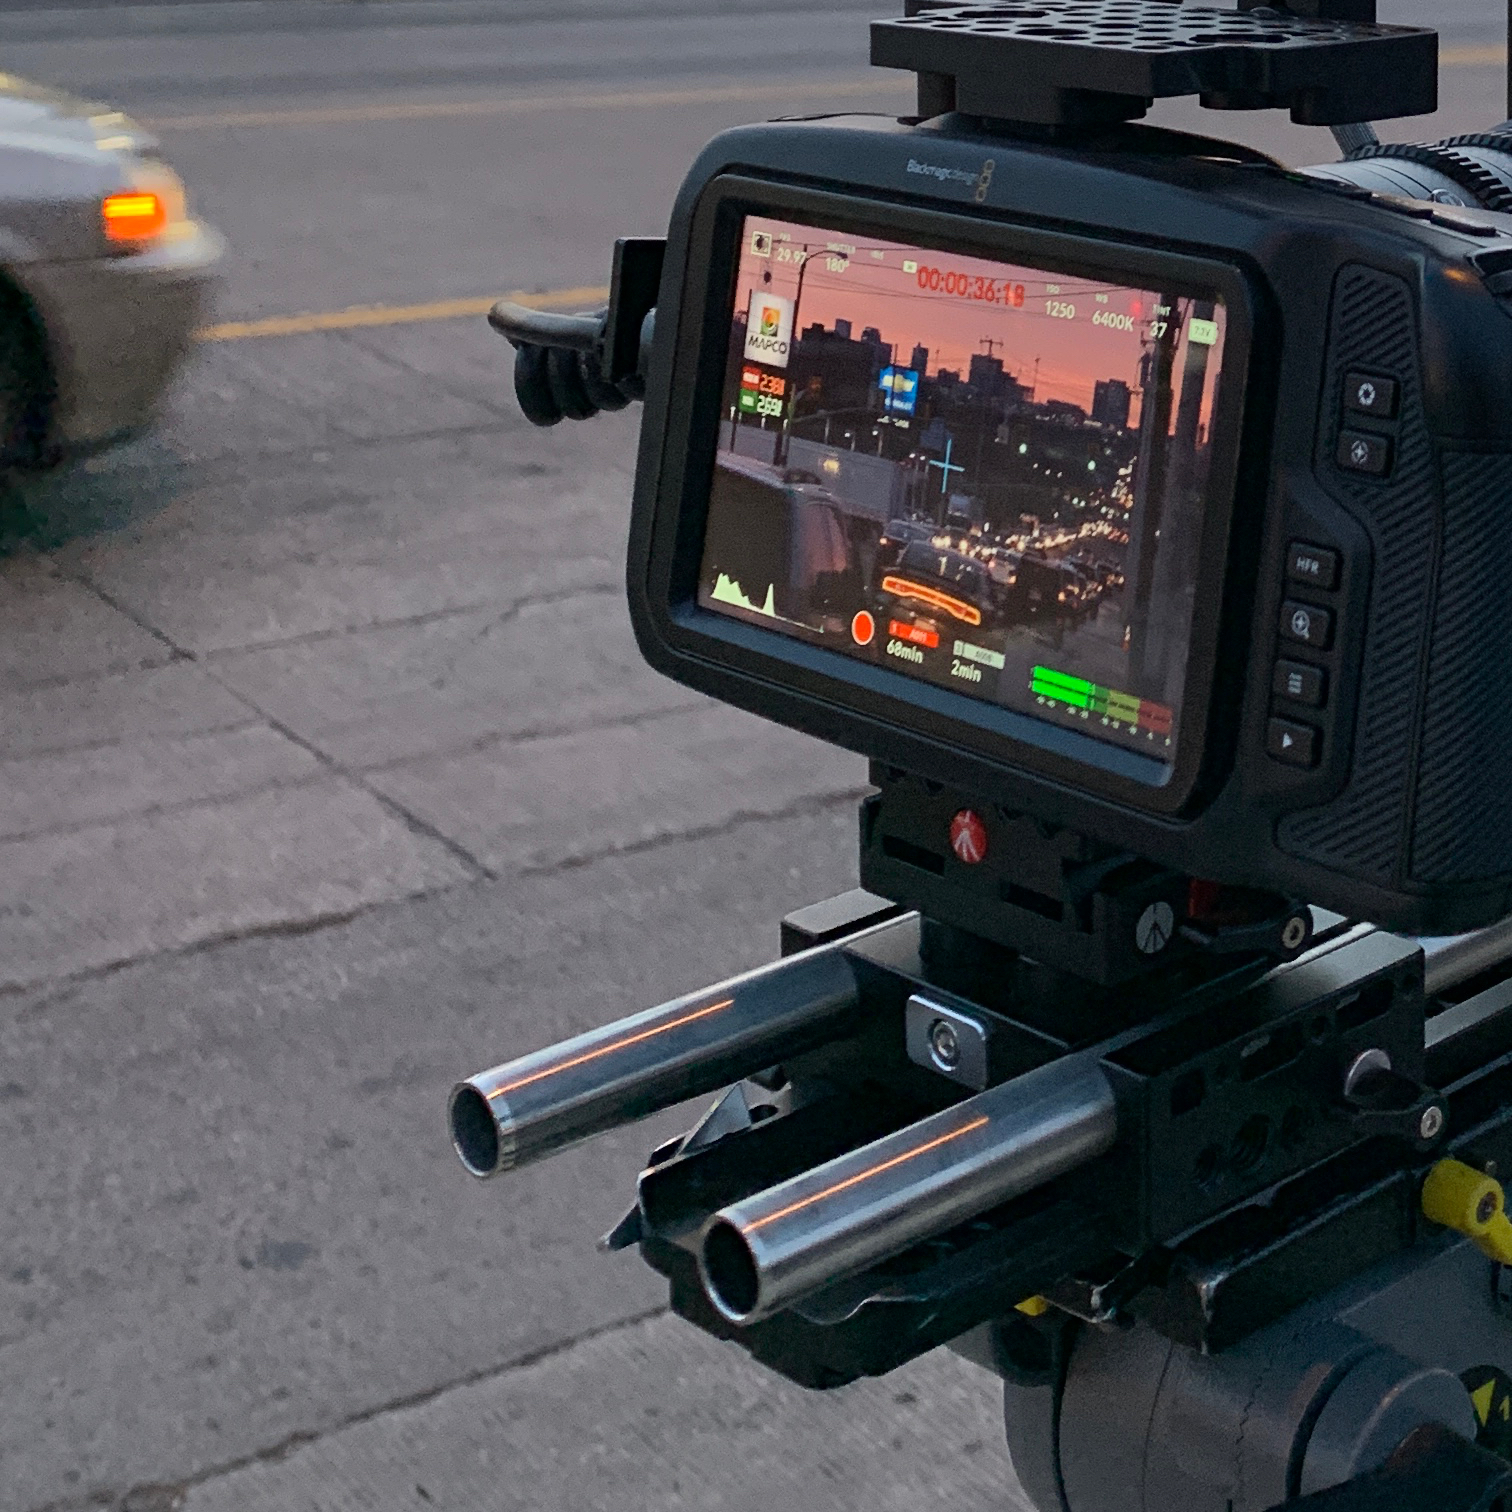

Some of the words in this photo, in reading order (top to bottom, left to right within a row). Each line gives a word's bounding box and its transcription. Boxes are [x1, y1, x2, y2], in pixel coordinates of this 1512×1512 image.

[777, 247, 807, 265] 29.97
[1044, 299, 1075, 320] 1250
[1092, 310, 1134, 332] 6400K
[1150, 320, 1168, 338] 37
[748, 335, 787, 355] MAPCO
[886, 638, 924, 664] 68min
[951, 659, 982, 683] 2min
